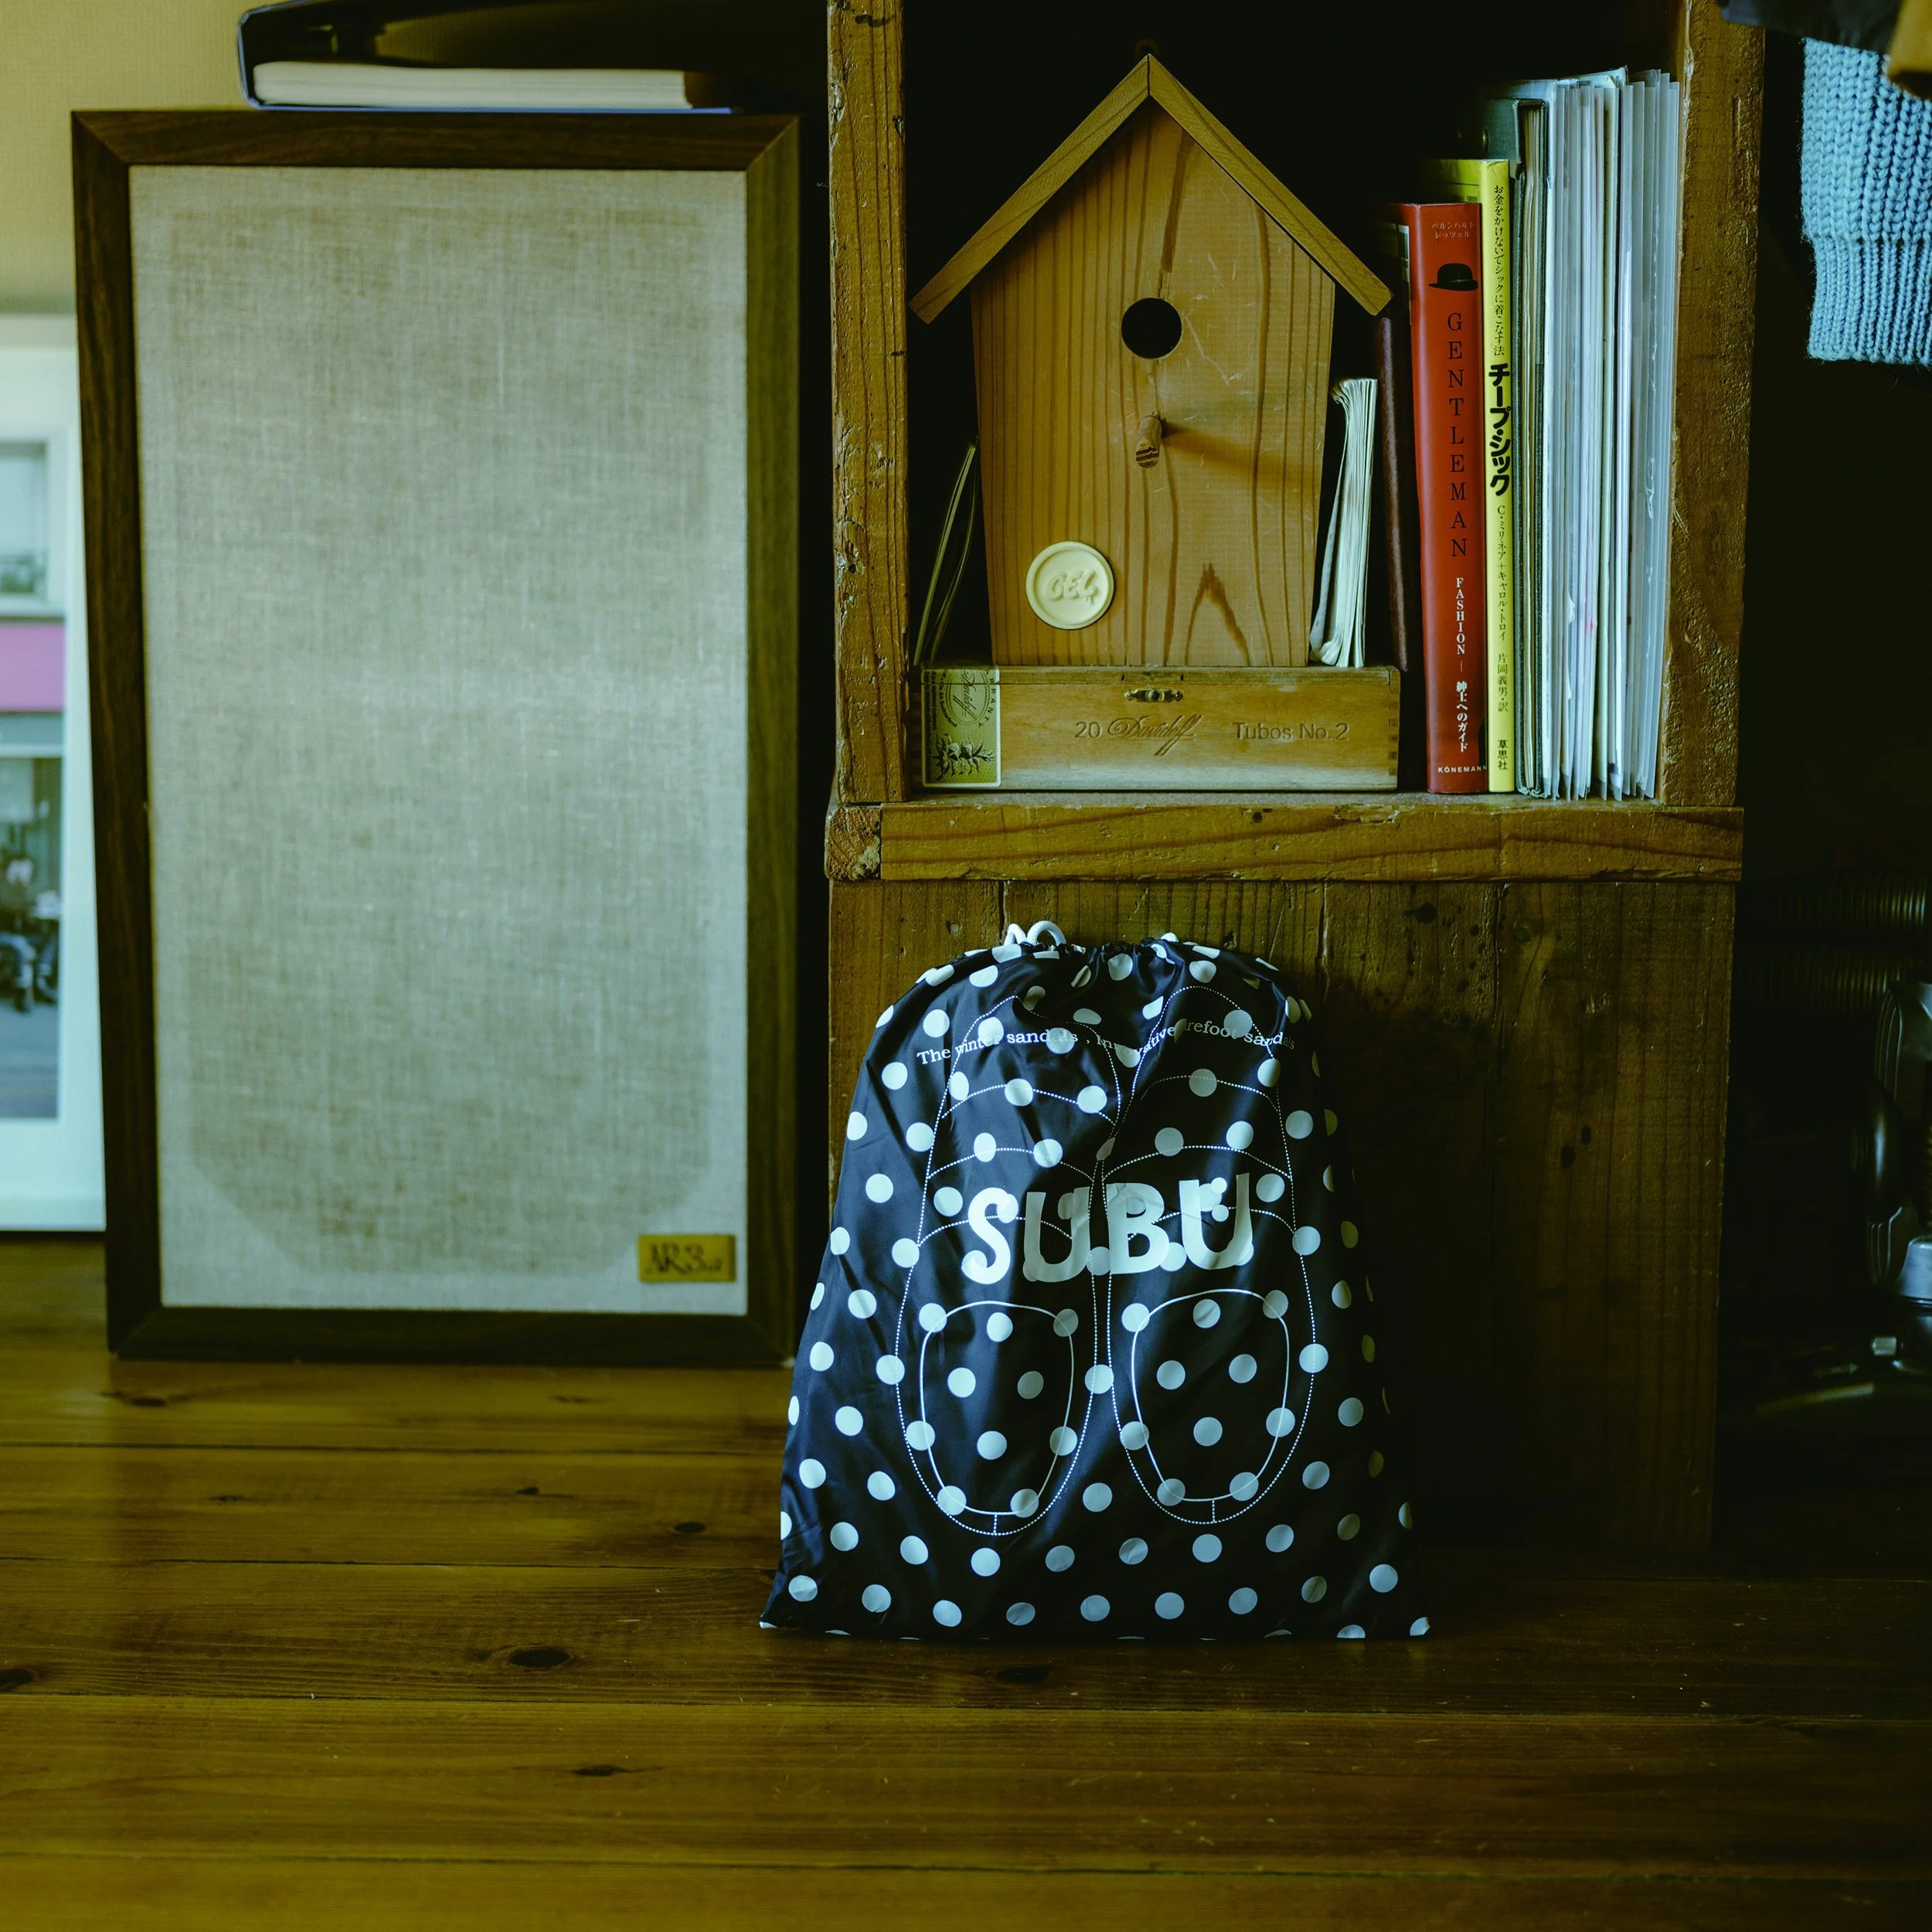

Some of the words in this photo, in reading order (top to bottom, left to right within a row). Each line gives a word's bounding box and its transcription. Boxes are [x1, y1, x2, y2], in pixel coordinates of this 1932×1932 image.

[1447, 312, 1468, 556] GENTLEMAN
[1488, 362, 1512, 497] チープ・シック
[1456, 577, 1465, 655] FASHION
[1075, 721, 1102, 740] 20
[1233, 722, 1294, 741] Tubos
[1456, 681, 1468, 753] 紳士へのガイド
[1498, 740, 1508, 771] 草思社
[917, 1048, 951, 1065] The
[961, 1172, 1253, 1284] SUBU
